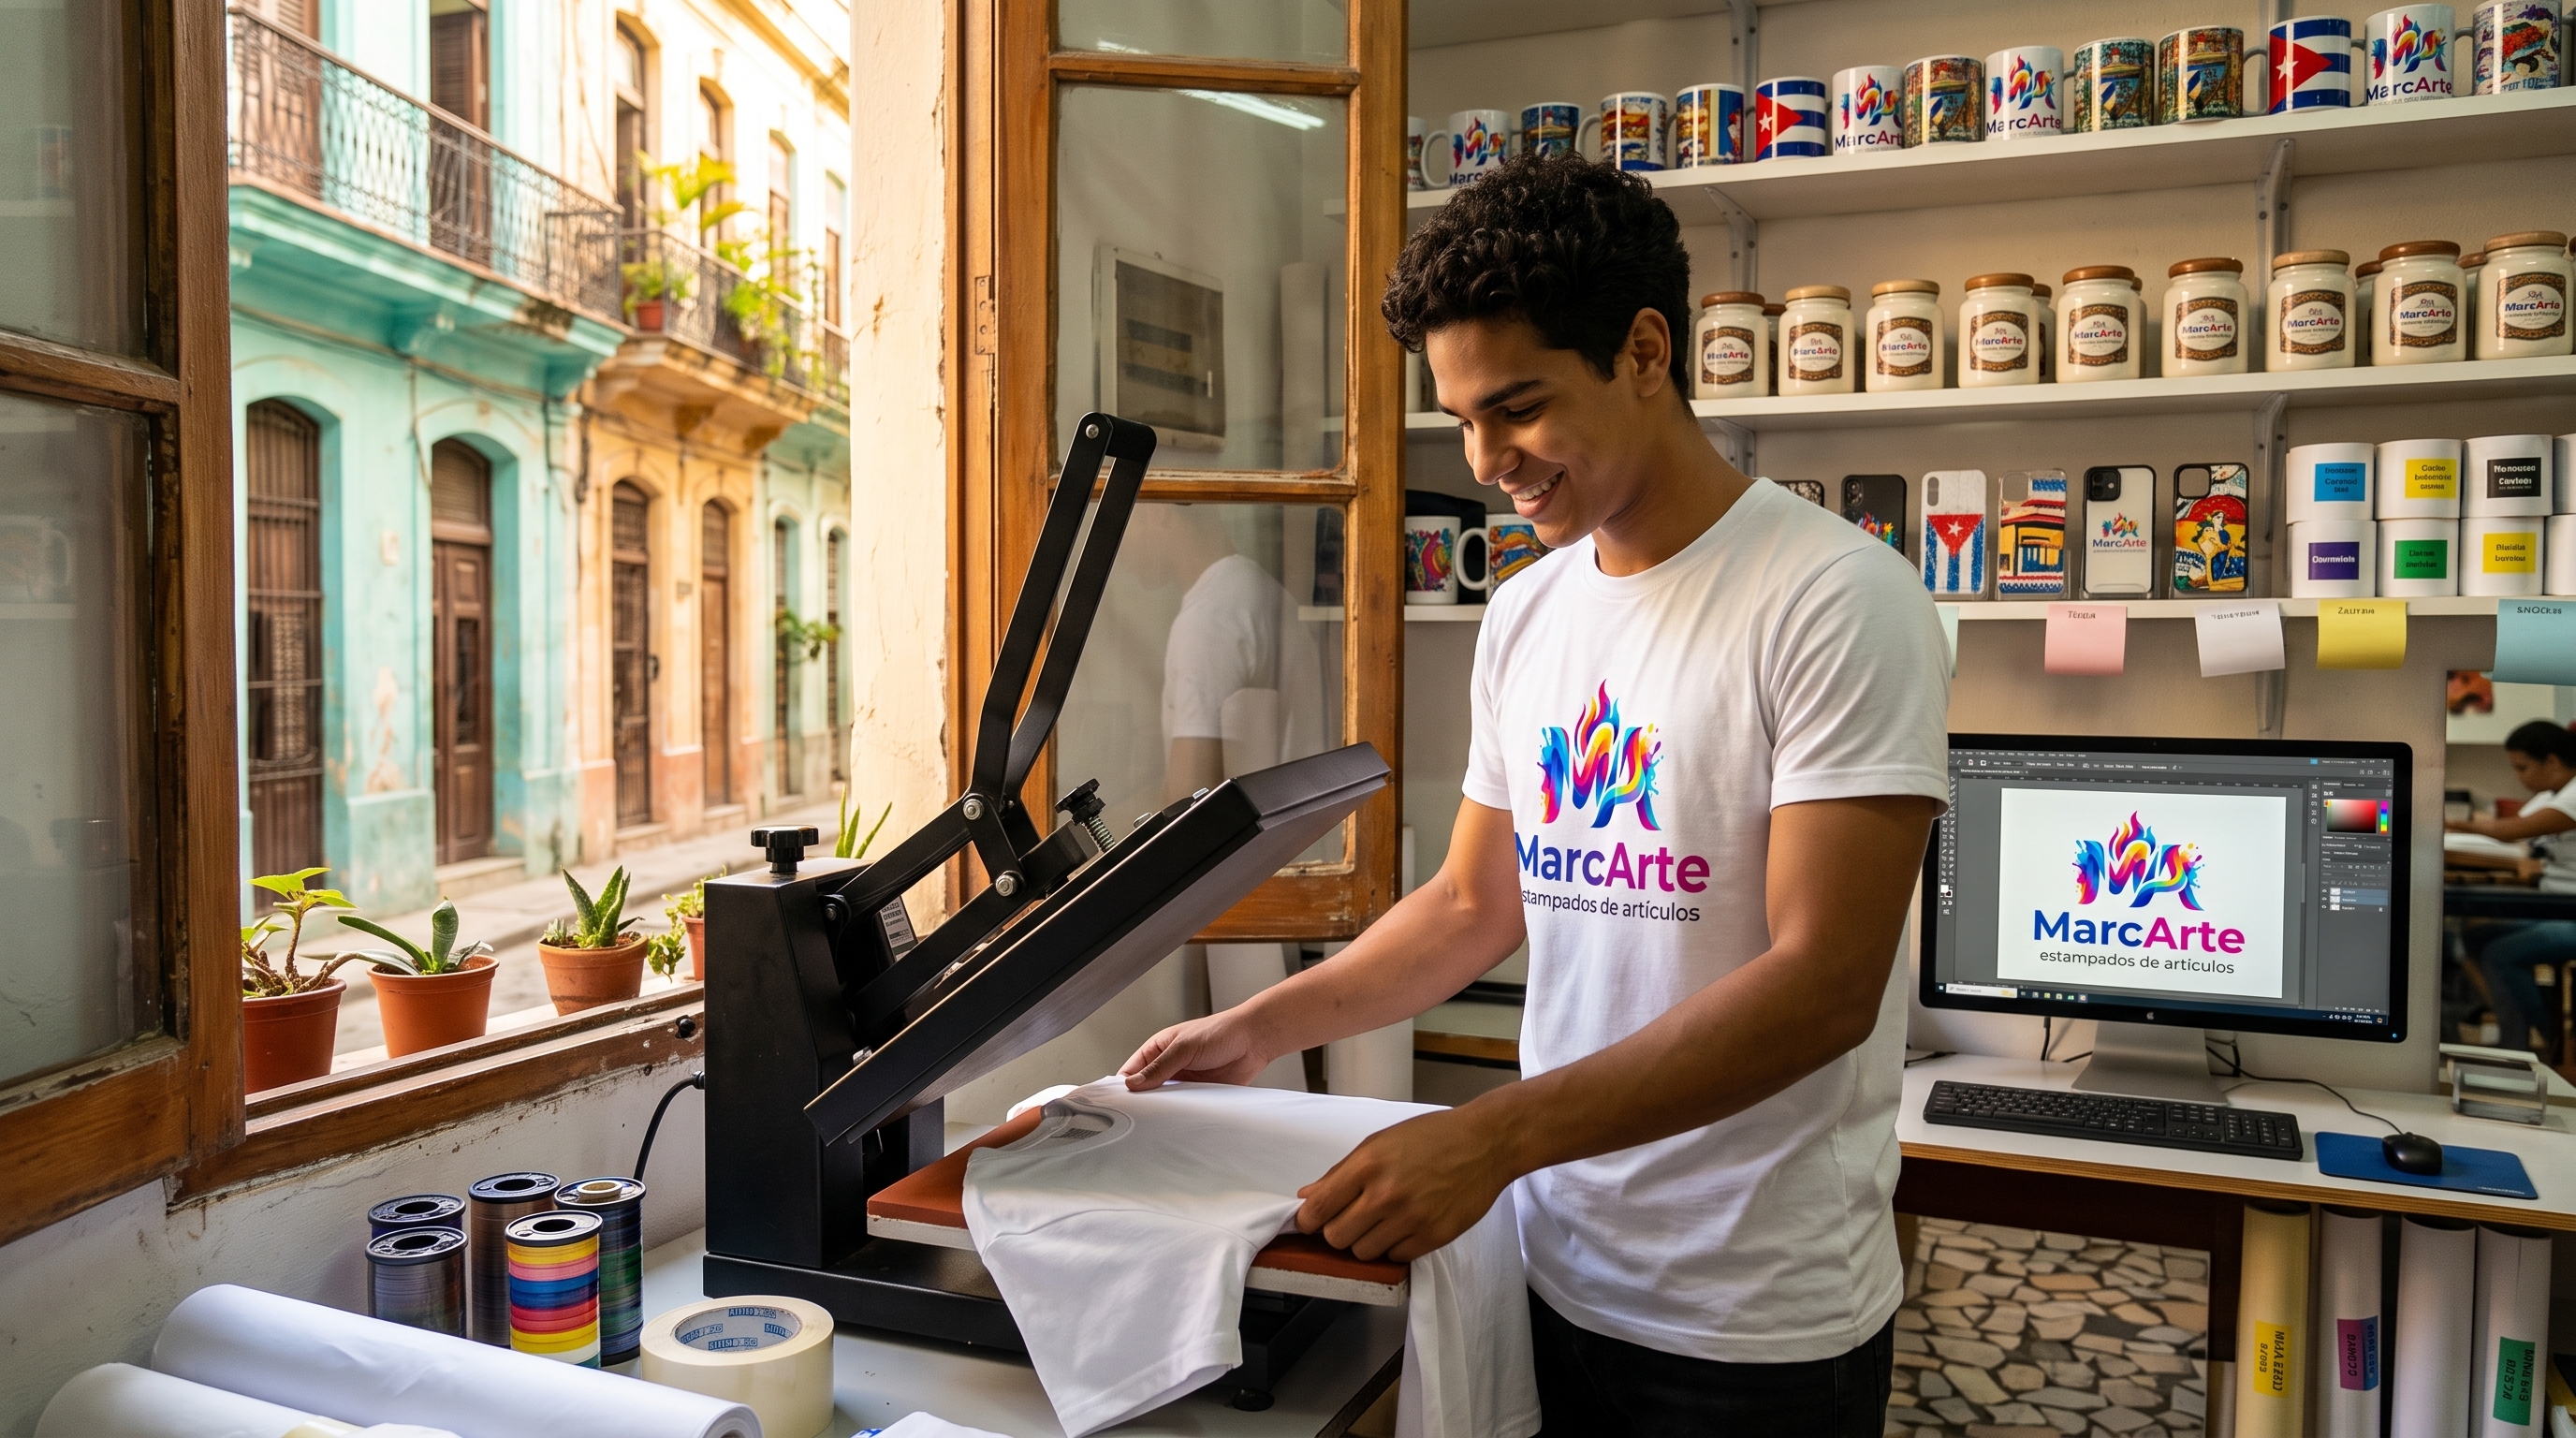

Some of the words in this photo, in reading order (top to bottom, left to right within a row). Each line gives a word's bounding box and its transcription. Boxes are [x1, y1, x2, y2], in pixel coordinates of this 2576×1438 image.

[2092, 538, 2147, 548] MarcArte
[1515, 831, 1711, 893] MarcArte
[1521, 888, 1597, 914] stampados
[1601, 896, 1618, 916] de
[1622, 900, 1700, 922] artículos
[2033, 909, 2246, 954] MarcArte
[2039, 950, 2135, 967] estampados
[2139, 955, 2160, 969] de
